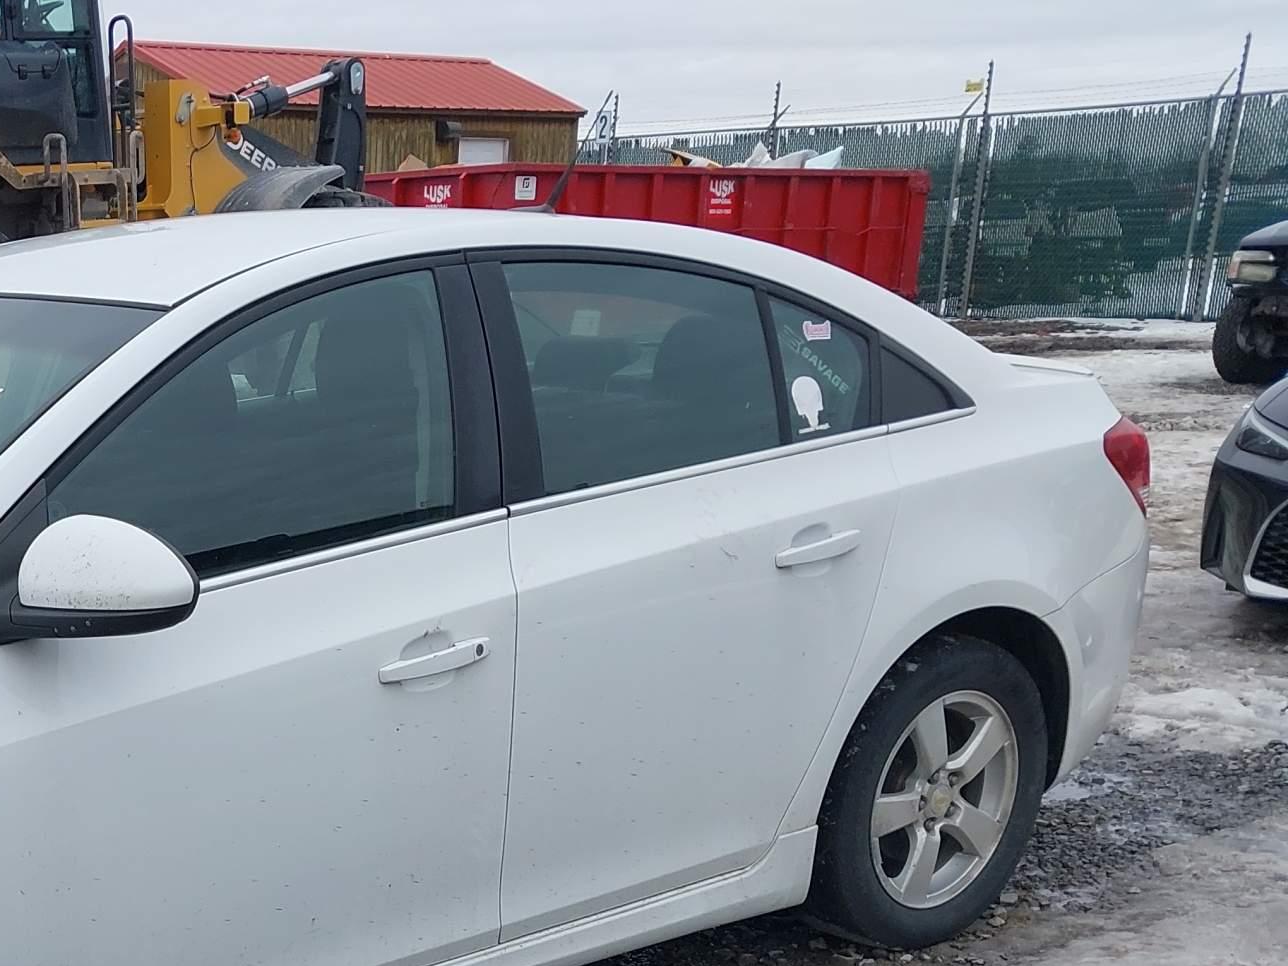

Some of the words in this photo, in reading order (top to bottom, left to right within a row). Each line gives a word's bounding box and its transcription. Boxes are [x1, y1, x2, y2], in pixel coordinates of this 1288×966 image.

[598, 115, 608, 139] 2
[423, 185, 452, 203] LUSK
[709, 179, 736, 198] LUSK
[801, 346, 849, 395] SAVAGE
